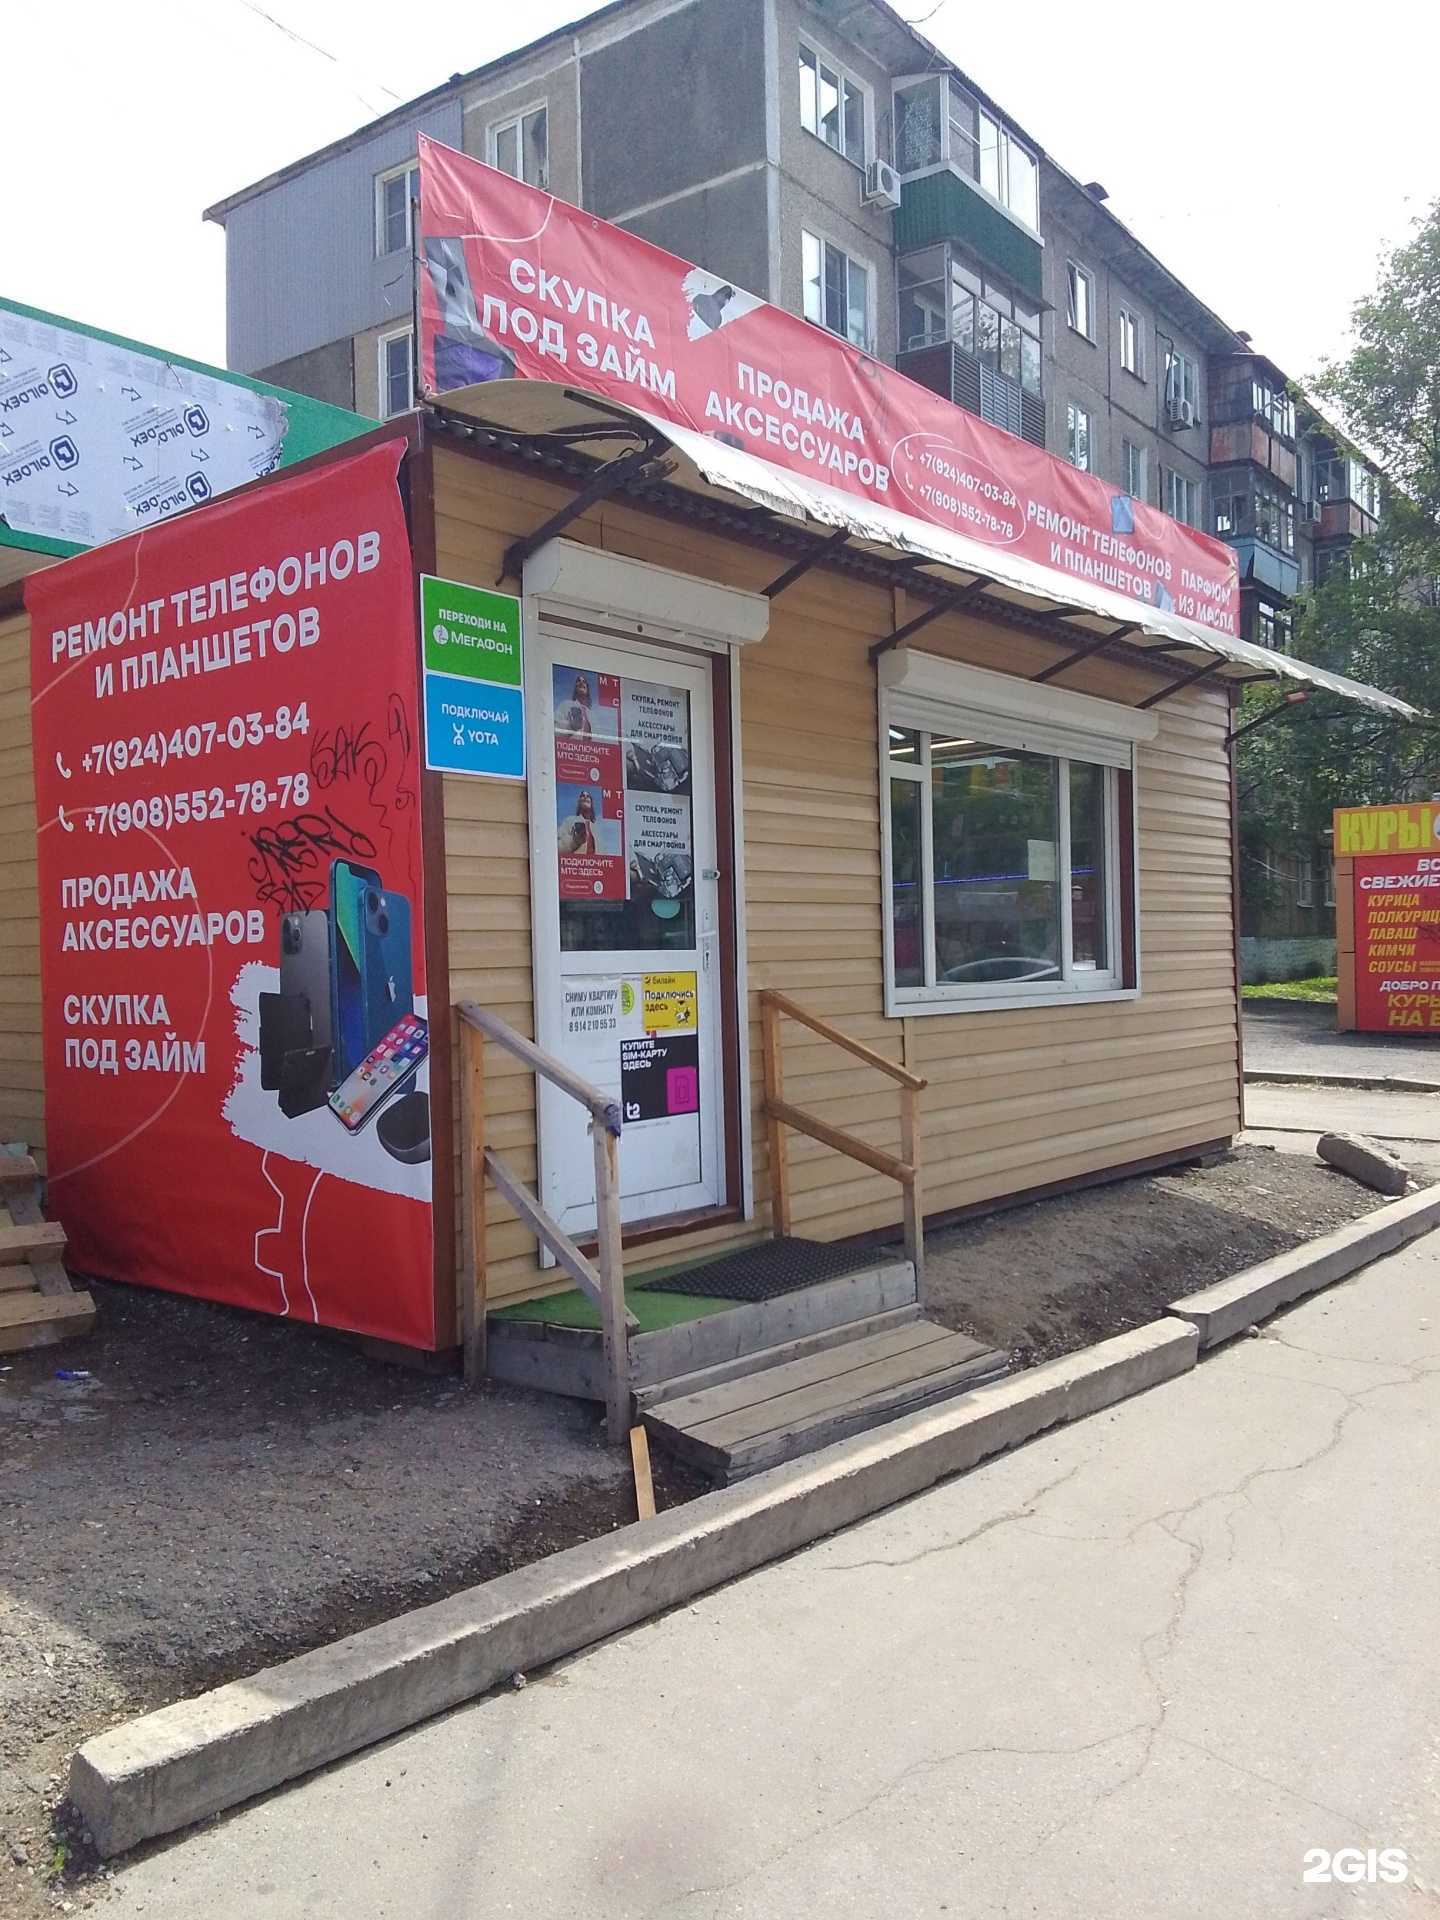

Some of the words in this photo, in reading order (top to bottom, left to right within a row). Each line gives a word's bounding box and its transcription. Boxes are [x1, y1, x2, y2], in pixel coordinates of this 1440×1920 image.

[509, 257, 656, 350] СКУПКА
[482, 294, 567, 363] ПОД
[577, 333, 677, 401] ЗАЙМ
[738, 361, 865, 446] ПРОДАЖА
[704, 391, 890, 493] АКСЕССУАРОВ
[1027, 500, 1090, 546] РЕМОНТ
[1092, 529, 1173, 581] ТЕЛЕФОНОВ
[1050, 541, 1061, 565] И
[1065, 548, 1153, 599] ПЛАНШЕТОВ
[1181, 568, 1231, 607] ПАРФЮМ
[52, 598, 165, 664] РЕМОНТ
[170, 530, 381, 628] ТЕЛЕФОНОВ
[1178, 593, 1194, 617] ИЗ
[439, 608, 492, 630] ПЕРЕХОДИ
[492, 621, 507, 634] НА
[95, 665, 113, 699] И
[122, 607, 321, 692] ПЛАНШЕТОВ
[441, 703, 509, 724] ПОДКЛЮЧАЙ
[82, 702, 310, 776] +7(924)407-03-84
[468, 729, 499, 746] YOTA
[556, 741, 611, 756] ПОДКЛЮЧИТЕ
[85, 772, 310, 837] +7(908)552-78-78
[642, 815, 677, 825] ТЕЛЕФОНОВ
[641, 830, 679, 839] АКСЕССУАРЫ
[1340, 808, 1432, 852] КУРЫ
[560, 857, 614, 868] ПОДКЛЮЧИТЕ
[560, 867, 577, 876] МТС
[578, 868, 604, 877] ЗДЕСЬ
[62, 867, 198, 909] ПРОДАЖА
[1360, 874, 1440, 889] СВЕЖИЕ
[1367, 894, 1419, 907] КУРИЦА
[1367, 910, 1440, 924] ПОЛКУРИЦ
[62, 910, 265, 952] АКСЕССУАРОВ
[1367, 928, 1418, 940] ЛАВАШ
[1368, 944, 1416, 957] КИМЧИ
[1368, 960, 1417, 973] СОУСЫ
[644, 989, 694, 1001] Подключись
[1380, 980, 1429, 993] ДОБРО
[565, 991, 588, 1003] СНИМУ
[588, 989, 618, 1001] КВАРТИРУ
[63, 994, 171, 1026] СКУПКА
[571, 1006, 585, 1017] ИЛИ
[585, 1004, 614, 1016] КОМНАТУ
[645, 1002, 668, 1013] здесь
[1387, 1010, 1424, 1027] НА
[65, 1038, 119, 1075] ПОД
[125, 1032, 206, 1074] ЗАЙМ
[622, 1040, 655, 1051] КУПИТЕ
[622, 1048, 668, 1060] SIM-КАРТУ
[622, 1060, 652, 1071] ЗДЕСЬ
[626, 1101, 640, 1119] t2
